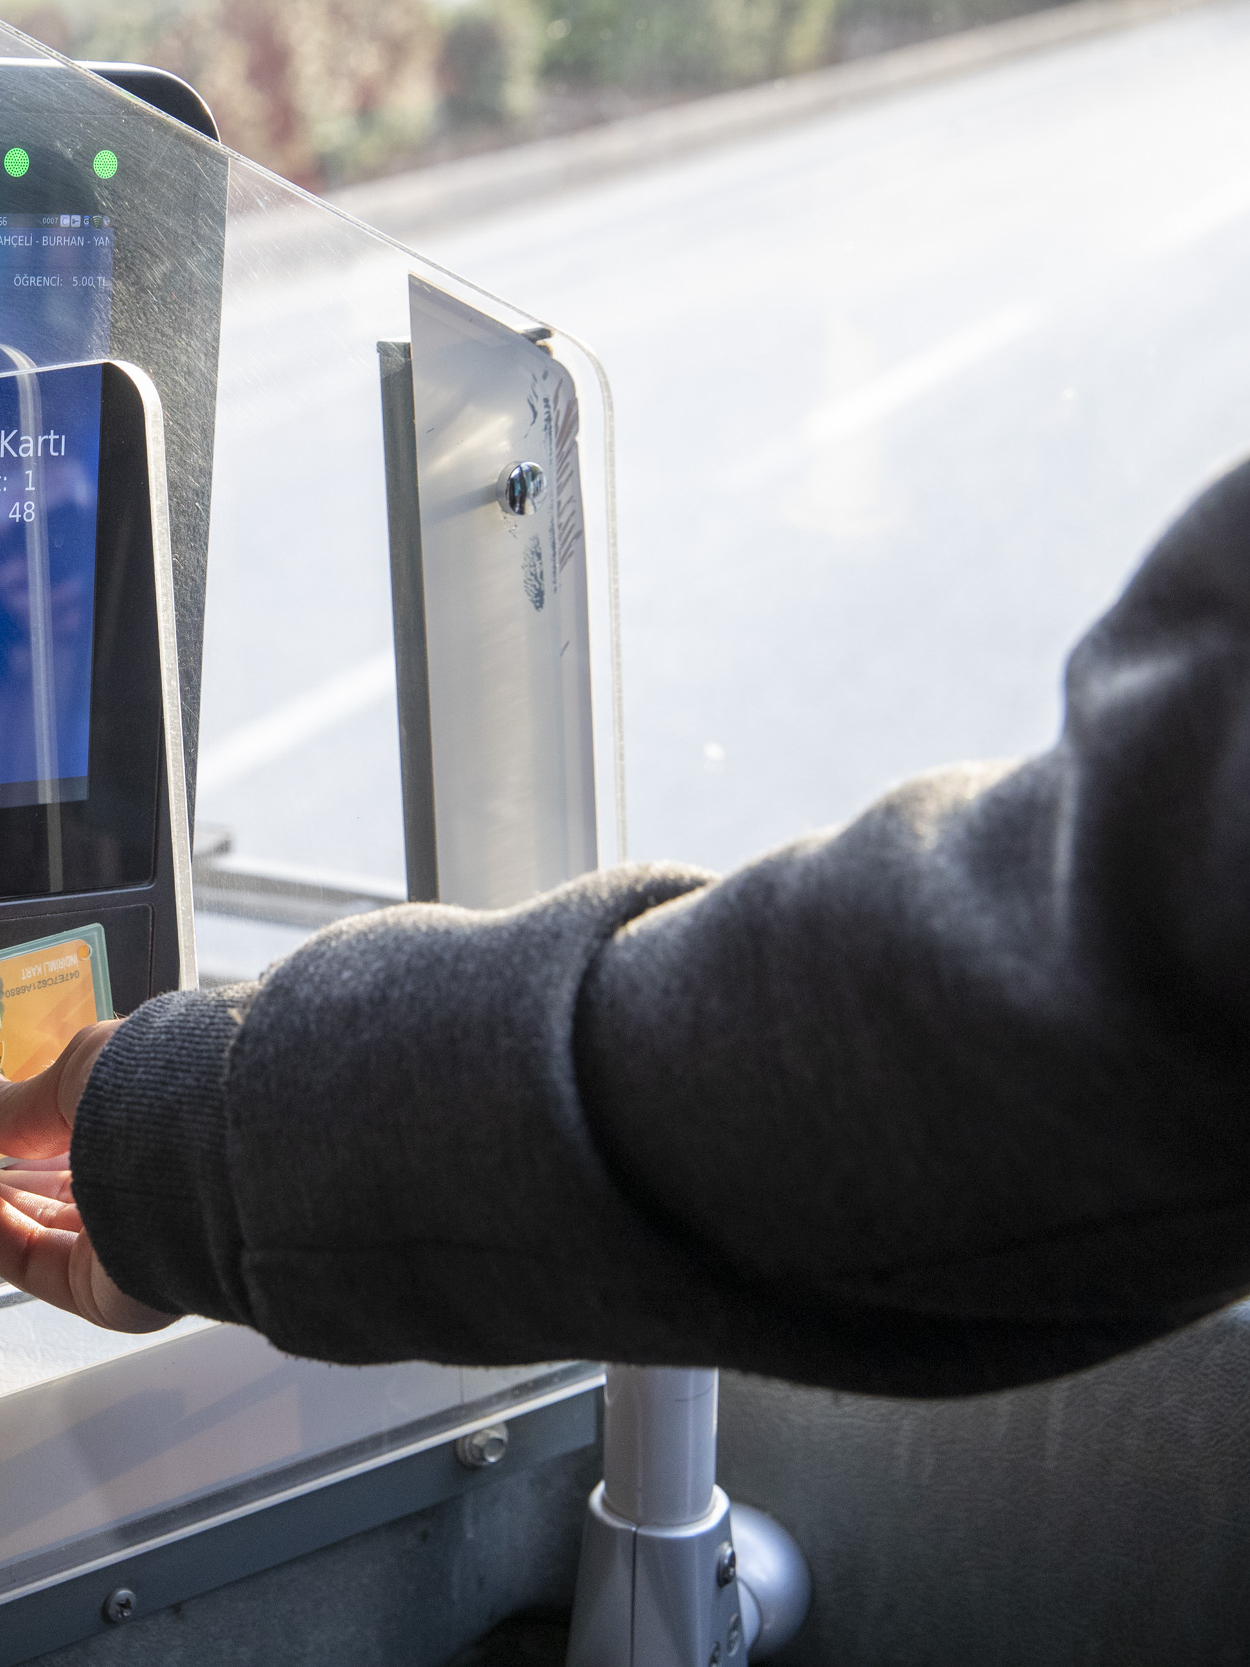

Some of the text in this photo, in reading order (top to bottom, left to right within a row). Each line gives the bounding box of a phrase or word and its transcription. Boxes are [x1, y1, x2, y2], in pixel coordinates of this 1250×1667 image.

[42, 217, 59, 225] 0007
[42, 235, 84, 247] BURHAN
[13, 273, 63, 288] ÖĞRENCİ:
[72, 276, 94, 288] 5.00
[0, 429, 66, 458] Kartı
[24, 470, 36, 491] 1
[8, 501, 35, 523] 48
[21, 963, 43, 981] KART
